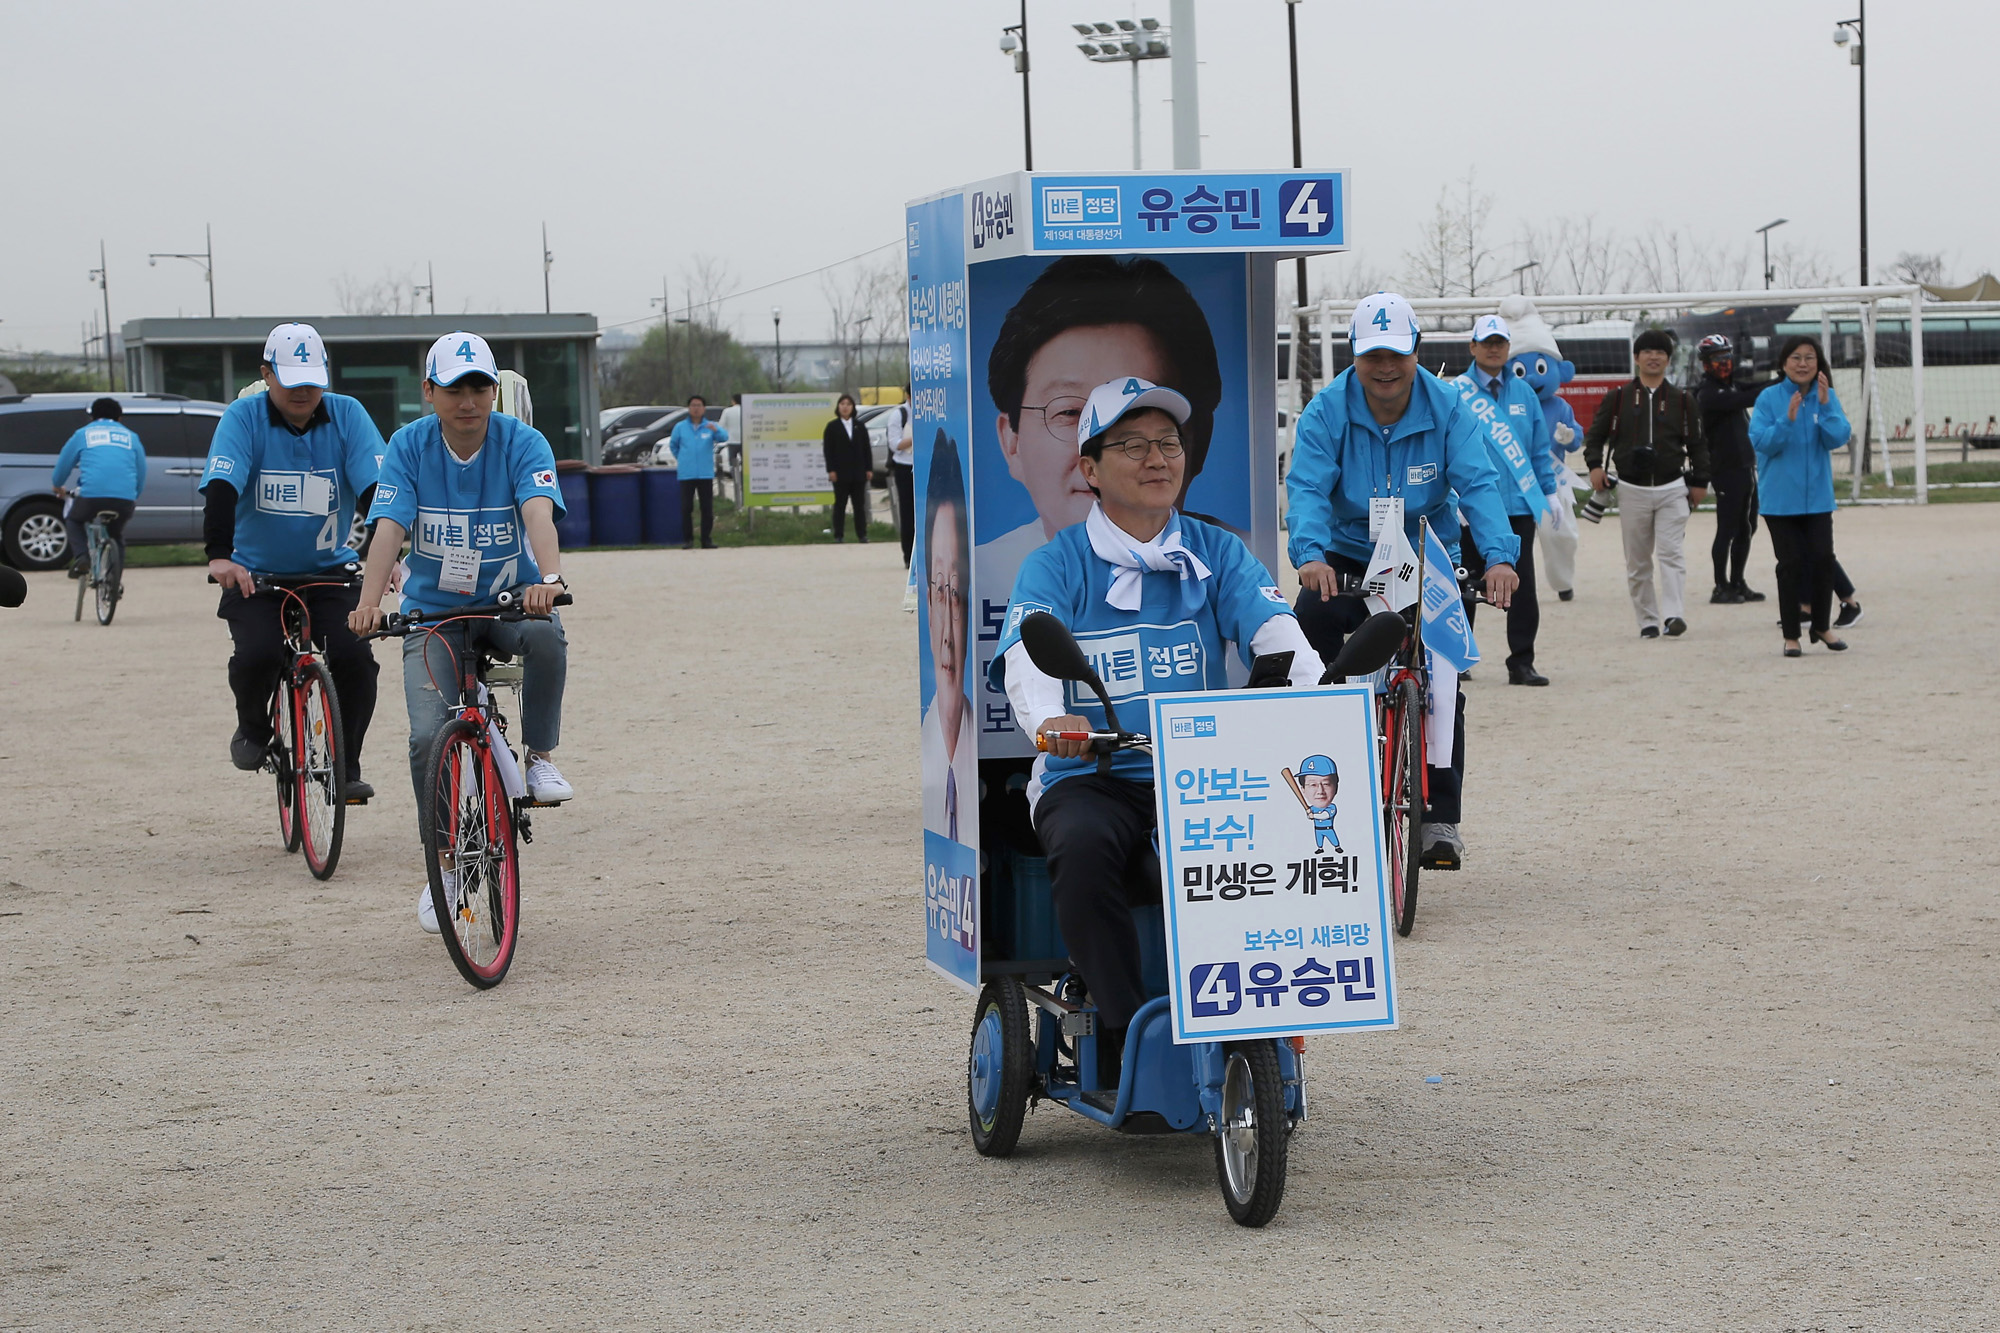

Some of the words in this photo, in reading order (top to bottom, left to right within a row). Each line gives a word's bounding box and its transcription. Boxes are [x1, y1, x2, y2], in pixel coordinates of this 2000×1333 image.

[985, 191, 1014, 240] 유승민
[1051, 198, 1079, 214] 바른
[1085, 197, 1116, 214] 정당
[1137, 184, 1261, 234] 유승민
[1285, 182, 1328, 233] 4
[1043, 229, 1073, 241] 제19대
[1076, 228, 1122, 241] 대통령선거
[911, 284, 937, 334] 보수의
[938, 279, 964, 330] 새희망
[1372, 307, 1391, 331] 4
[1487, 319, 1497, 330] 4
[293, 342, 310, 363] 4
[456, 341, 476, 362] 4
[1471, 398, 1526, 469] 유승민
[1893, 421, 1998, 438] MRACLE
[264, 483, 298, 502] 바른
[316, 512, 338, 552] 4
[423, 523, 464, 548] 바른
[473, 521, 514, 547] 정당
[1084, 648, 1138, 683] 바른
[1148, 642, 1200, 679] 정당
[1174, 721, 1193, 733] 바른
[1195, 720, 1215, 732] 정당
[1308, 760, 1315, 770] 4
[1174, 767, 1270, 805] 안보는
[1180, 814, 1254, 852] 보수!
[1183, 862, 1277, 902] 민생은
[1285, 855, 1359, 895] 개혁!
[927, 863, 961, 943] 유승민
[962, 877, 974, 948] 4
[1244, 926, 1304, 951] 보수의
[1310, 922, 1371, 948] 새희망
[1196, 964, 1236, 1011] 4
[1245, 956, 1376, 1008] 유승민
